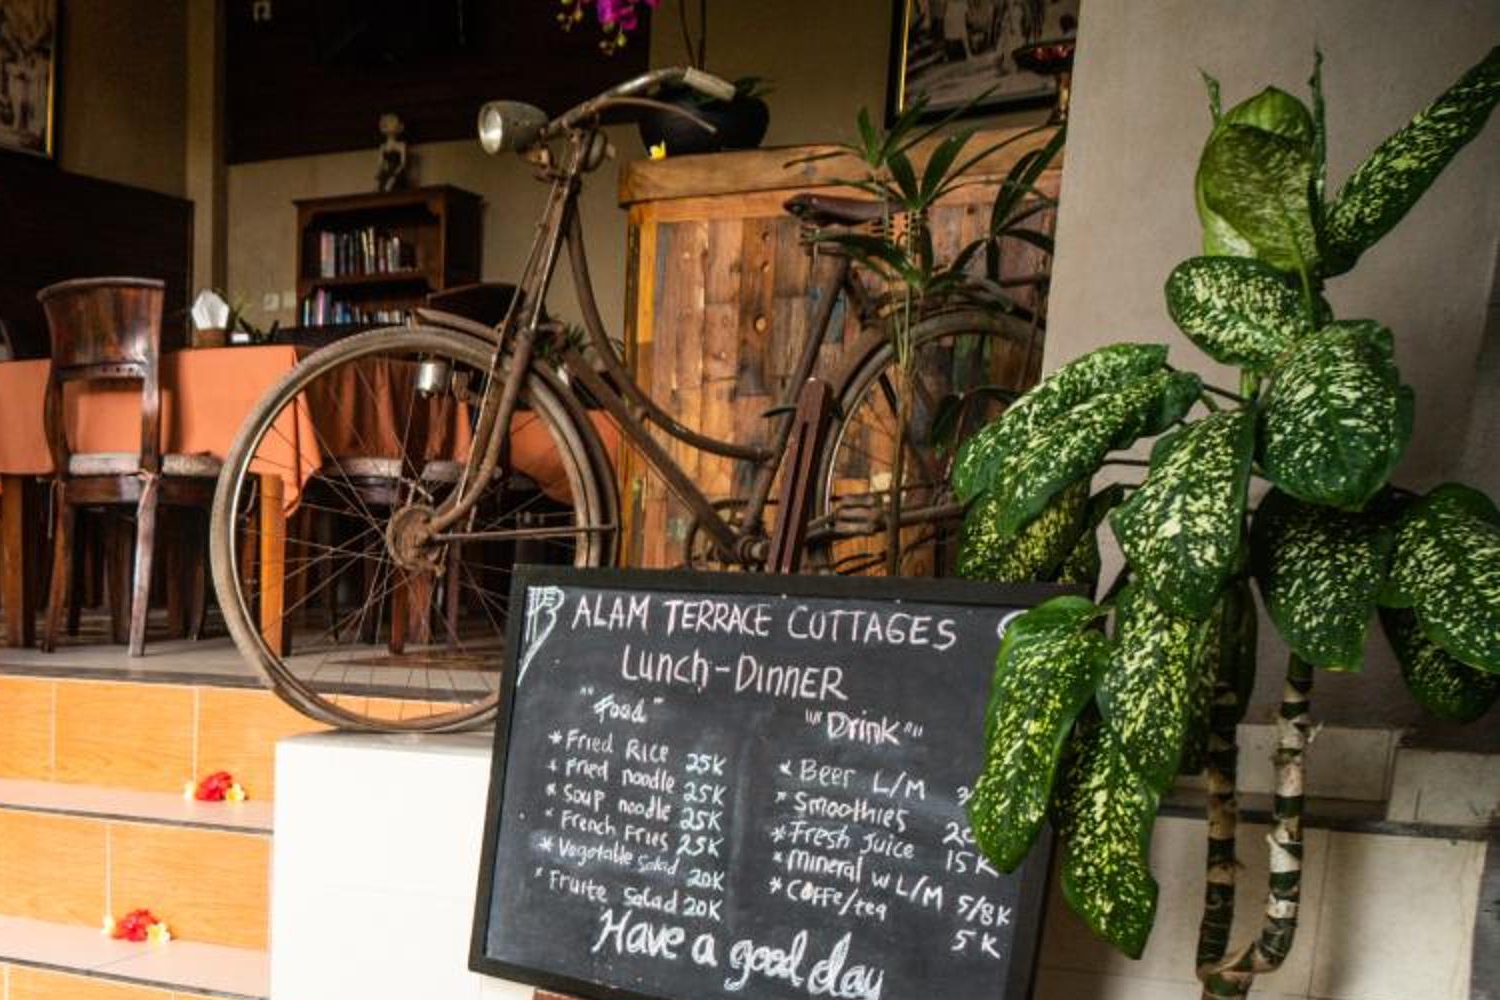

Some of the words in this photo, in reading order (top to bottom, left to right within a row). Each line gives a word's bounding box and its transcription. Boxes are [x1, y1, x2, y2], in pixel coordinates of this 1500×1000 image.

[571, 594, 651, 636] ALAM
[664, 600, 773, 637] TERRACE
[787, 605, 957, 651] COTTAGES
[565, 729, 613, 754] Fried
[685, 753, 727, 776] 25K
[800, 758, 857, 788] Beer
[565, 757, 609, 781] Fried
[622, 767, 676, 794] noodle
[683, 781, 727, 807] 25K
[561, 810, 616, 836] French
[676, 834, 724, 858] 25K
[618, 795, 672, 822] noodle
[679, 807, 724, 832] 25K
[790, 821, 850, 850] Fresh
[687, 869, 725, 891] 20K
[682, 896, 722, 921] 20K
[592, 908, 685, 960] Have
[691, 932, 718, 968] a
[723, 929, 804, 991] good
